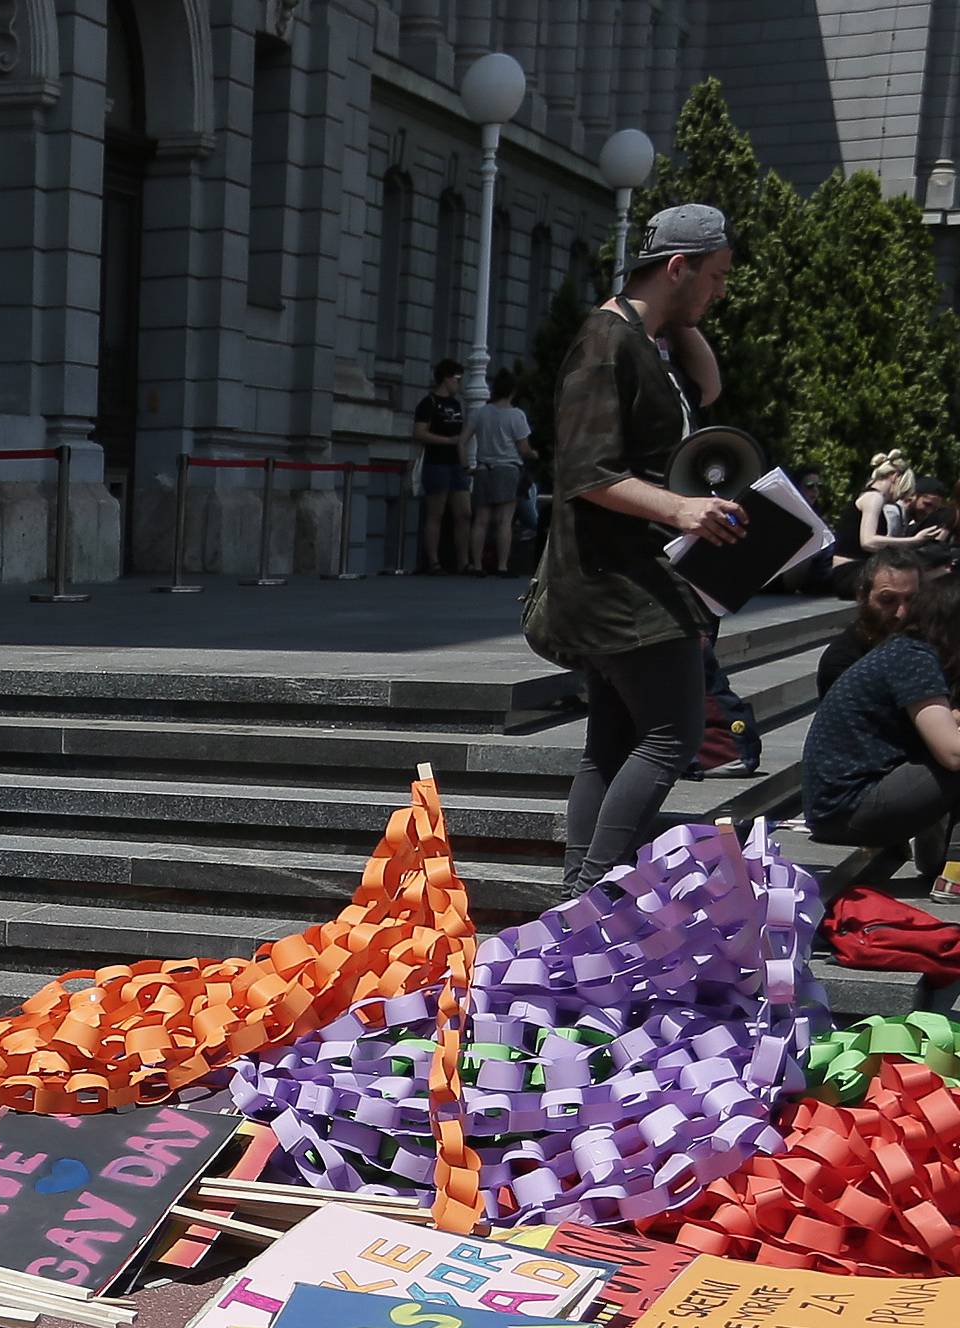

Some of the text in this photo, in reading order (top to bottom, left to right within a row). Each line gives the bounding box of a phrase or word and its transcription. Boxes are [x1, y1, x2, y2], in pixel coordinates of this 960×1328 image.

[25, 1107, 210, 1284] GAY DAY
[218, 1238, 432, 1322] TKE
[668, 1278, 741, 1320] SRETNI
[865, 1280, 942, 1327] PRAVA
[801, 1293, 855, 1316] ZA
